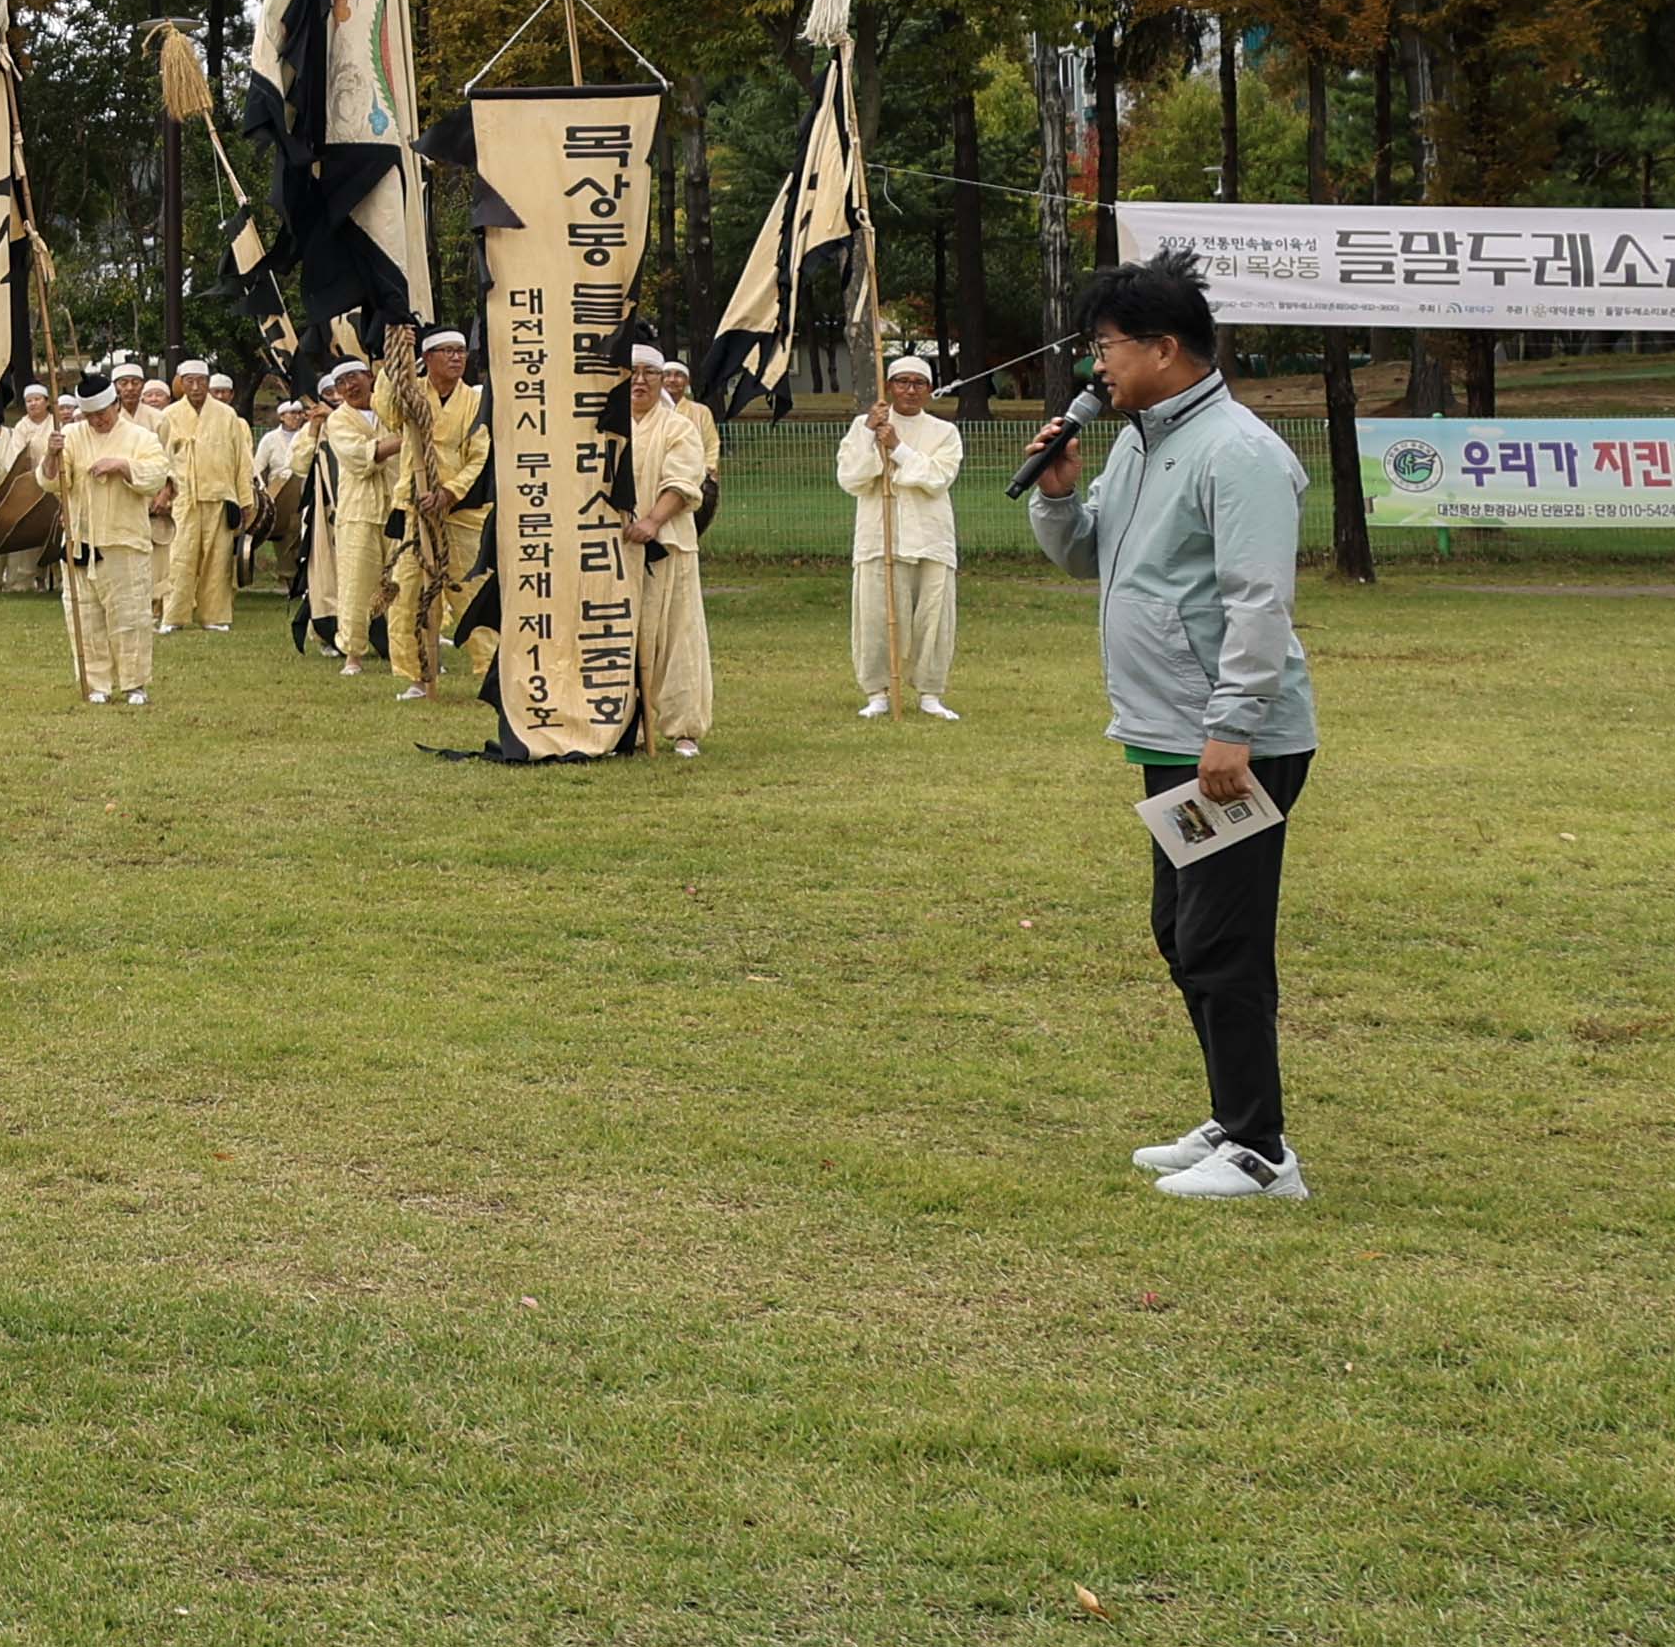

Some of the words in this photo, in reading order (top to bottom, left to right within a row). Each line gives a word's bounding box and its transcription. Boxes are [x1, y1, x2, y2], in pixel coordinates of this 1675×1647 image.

[563, 124, 633, 267] 목상동
[1158, 236, 1196, 249] 2024
[1201, 236, 1318, 251] 전통민속놀이육성
[1199, 255, 1238, 278] 7회
[1246, 255, 1321, 279] 목상동
[1335, 230, 1675, 288] 들말두레소
[509, 288, 549, 436] 대전광역시
[1461, 440, 1579, 488] 우리가
[1592, 440, 1675, 488] 지킨
[516, 452, 554, 598] 무형문화재
[1484, 504, 1538, 518] 환경감시단
[1541, 504, 1585, 518] 단원모집
[1594, 504, 1617, 518] 단장
[517, 613, 564, 730] 제13호
[578, 597, 634, 725] 보존회
